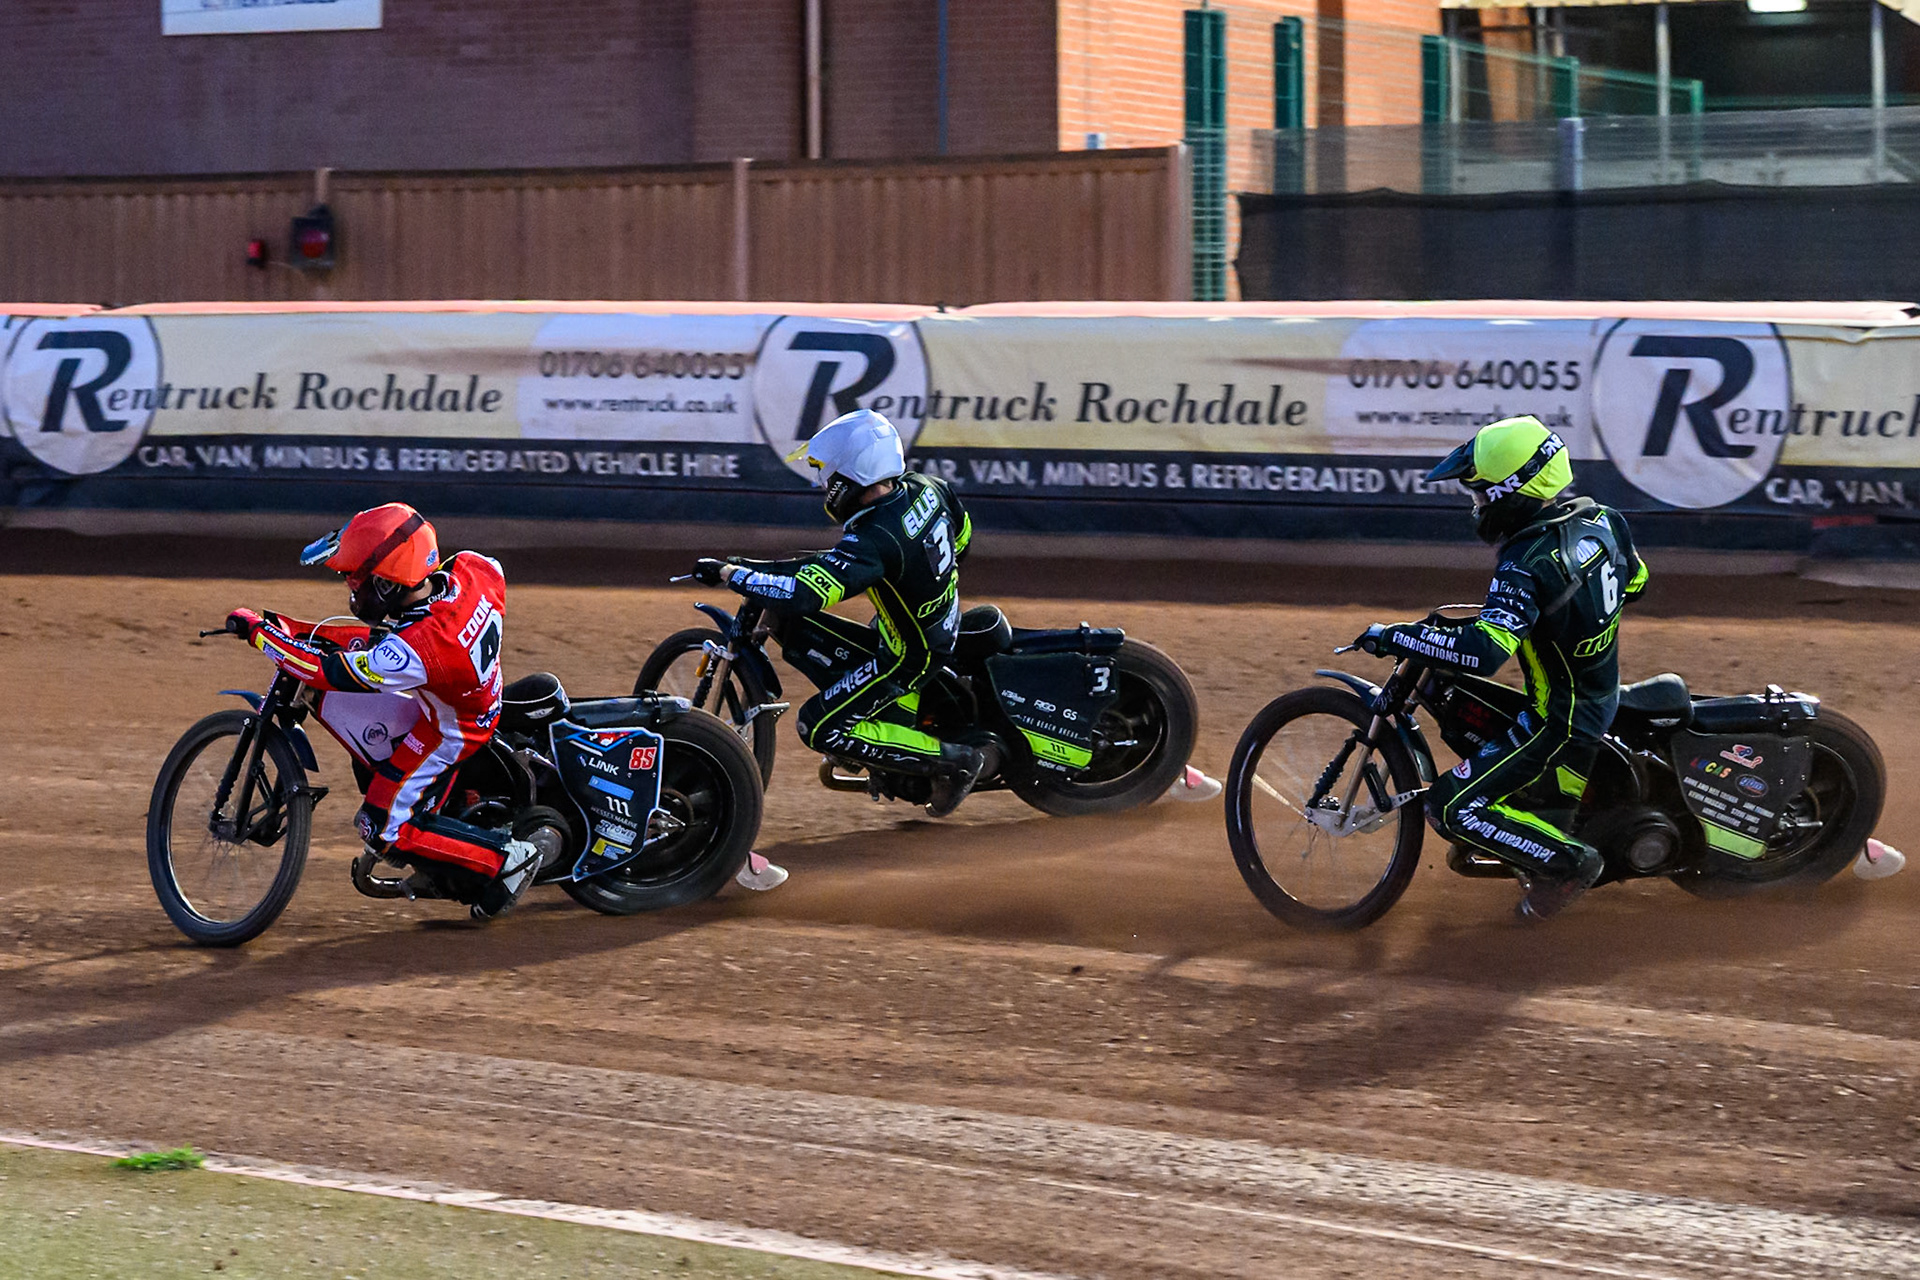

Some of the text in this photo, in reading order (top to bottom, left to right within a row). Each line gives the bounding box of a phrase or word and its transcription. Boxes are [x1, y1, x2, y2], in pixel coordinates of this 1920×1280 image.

[37, 330, 503, 433] Rentruck Rochdale
[539, 351, 746, 381] 01706 640055
[1349, 358, 1581, 392] 01706 640055
[787, 331, 1309, 441] Rentruck Rochdale
[138, 445, 740, 479] CAR, VAN, MINIBUS & REFRIGERATED VEHICLE HIRE
[969, 459, 1036, 489] VAN,
[1042, 461, 1157, 489] MINIBUS
[1163, 463, 1186, 489] &
[1191, 464, 1387, 494] REFRIGERATED
[1764, 477, 1834, 509] CAR,
[902, 486, 940, 538] ELLIS
[932, 520, 951, 576] 3
[815, 575, 833, 593] OIL
[1601, 560, 1619, 615] 6
[457, 594, 493, 648] COOK
[379, 644, 403, 666] ATPI
[479, 620, 501, 675] 4
[1393, 630, 1479, 669] FABRICATIONS LTD
[1092, 666, 1111, 692] 3
[1063, 708, 1078, 721] GS
[588, 757, 620, 776] LINK
[1690, 758, 1732, 778] LUCAS
